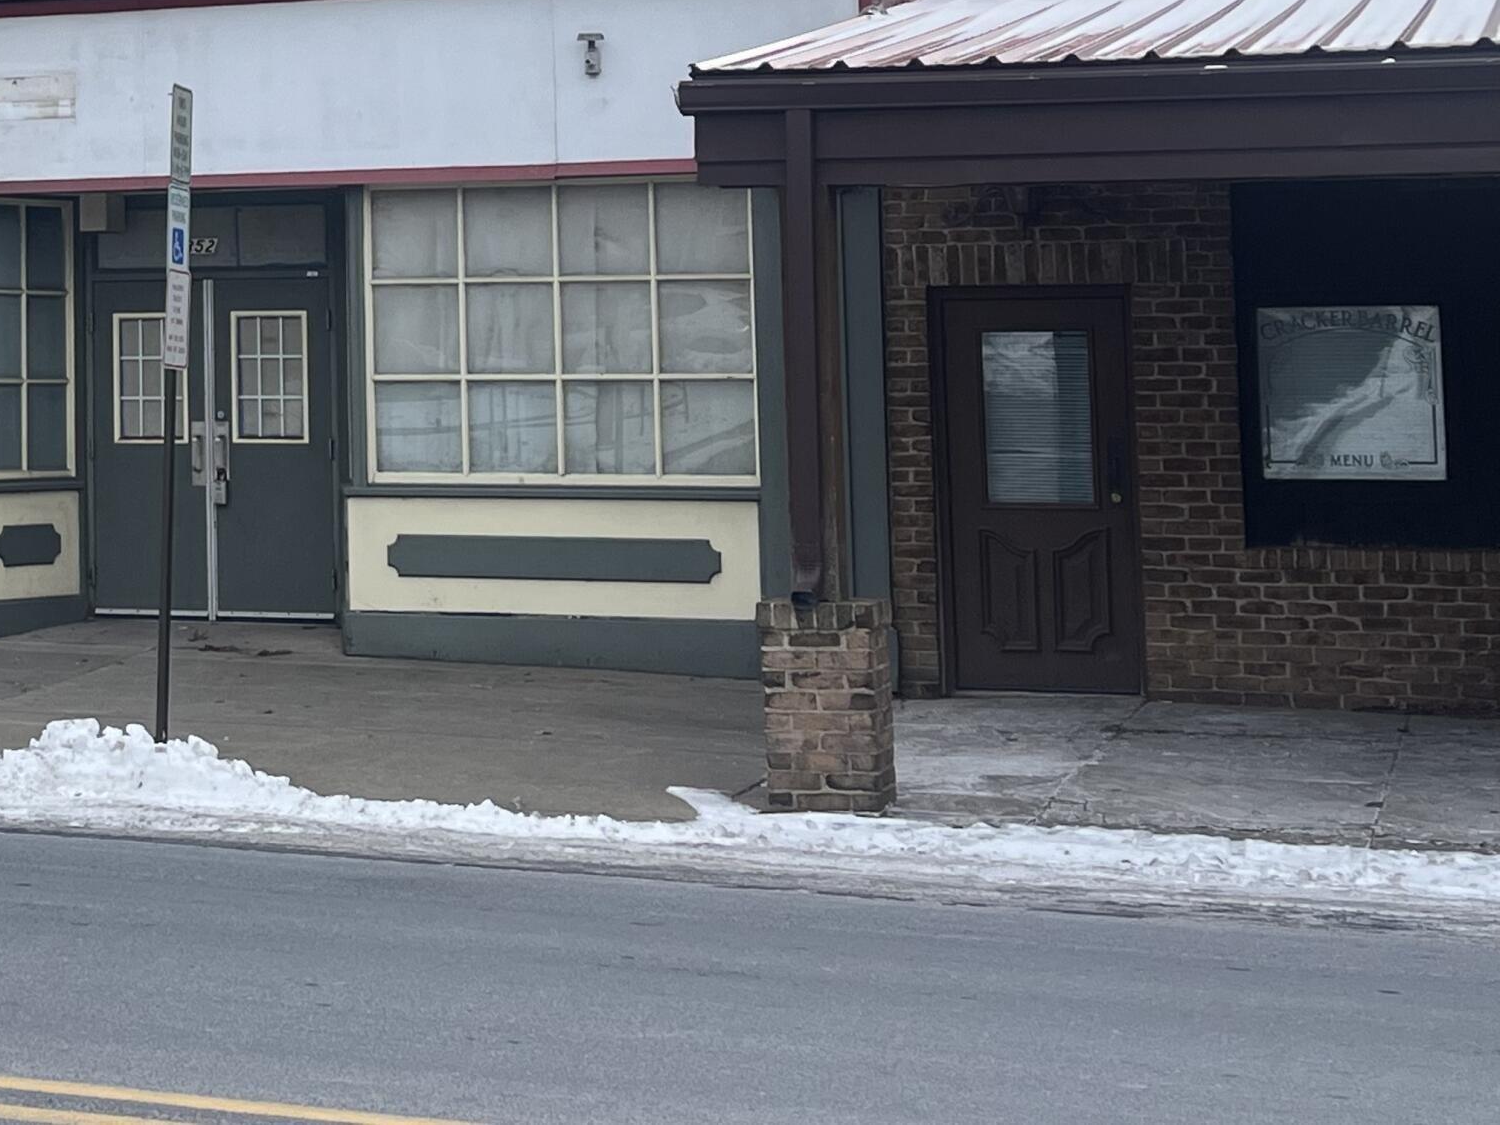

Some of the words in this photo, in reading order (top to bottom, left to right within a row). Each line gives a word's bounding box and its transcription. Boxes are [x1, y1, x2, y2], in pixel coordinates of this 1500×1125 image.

[1260, 309, 1353, 341] CRACKER
[1355, 309, 1436, 343] BARREL
[1330, 454, 1375, 467] MENU
